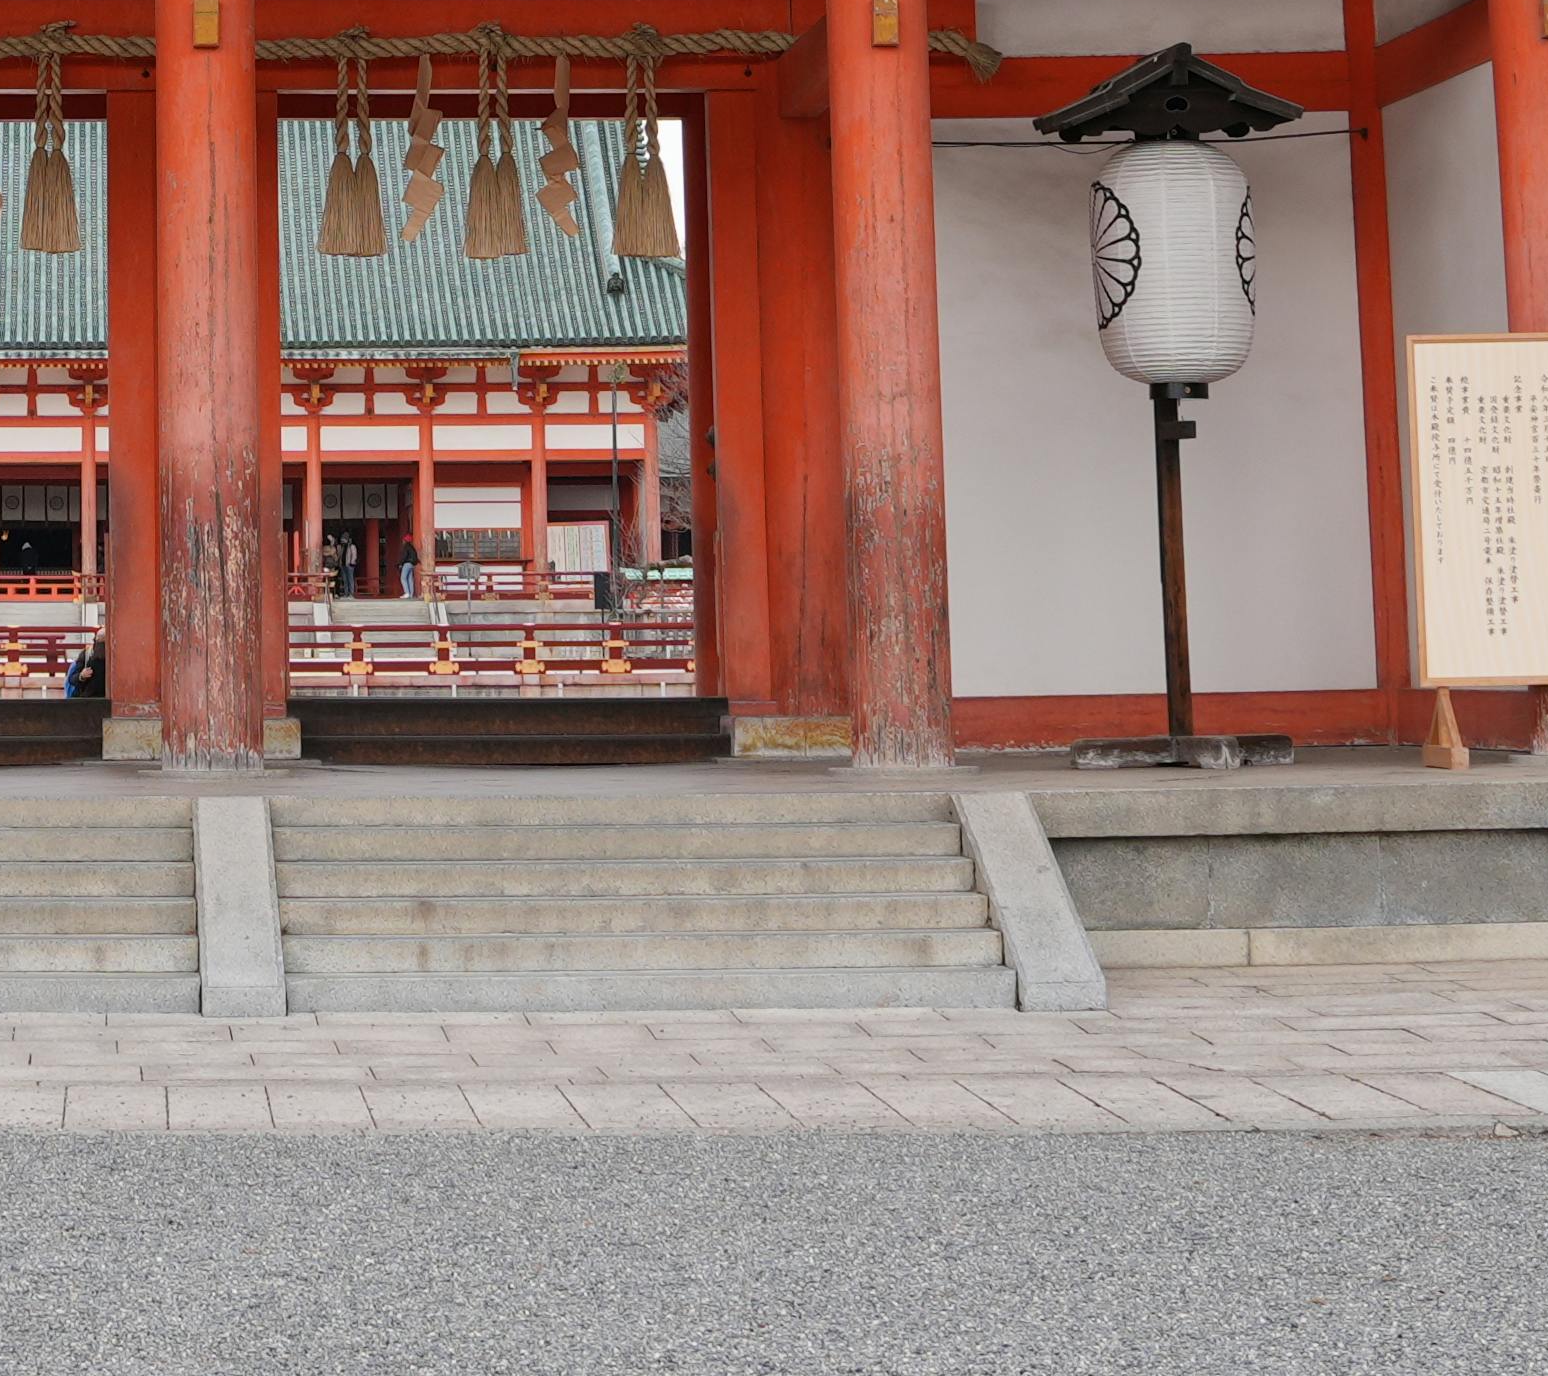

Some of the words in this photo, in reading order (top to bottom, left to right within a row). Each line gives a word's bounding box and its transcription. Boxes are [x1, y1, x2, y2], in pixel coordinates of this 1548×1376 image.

[1512, 374, 1523, 414] 記念事業
[1476, 394, 1487, 445] 重要文化財
[1501, 393, 1513, 444] 重要文化財
[1446, 436, 1457, 465] 四億円
